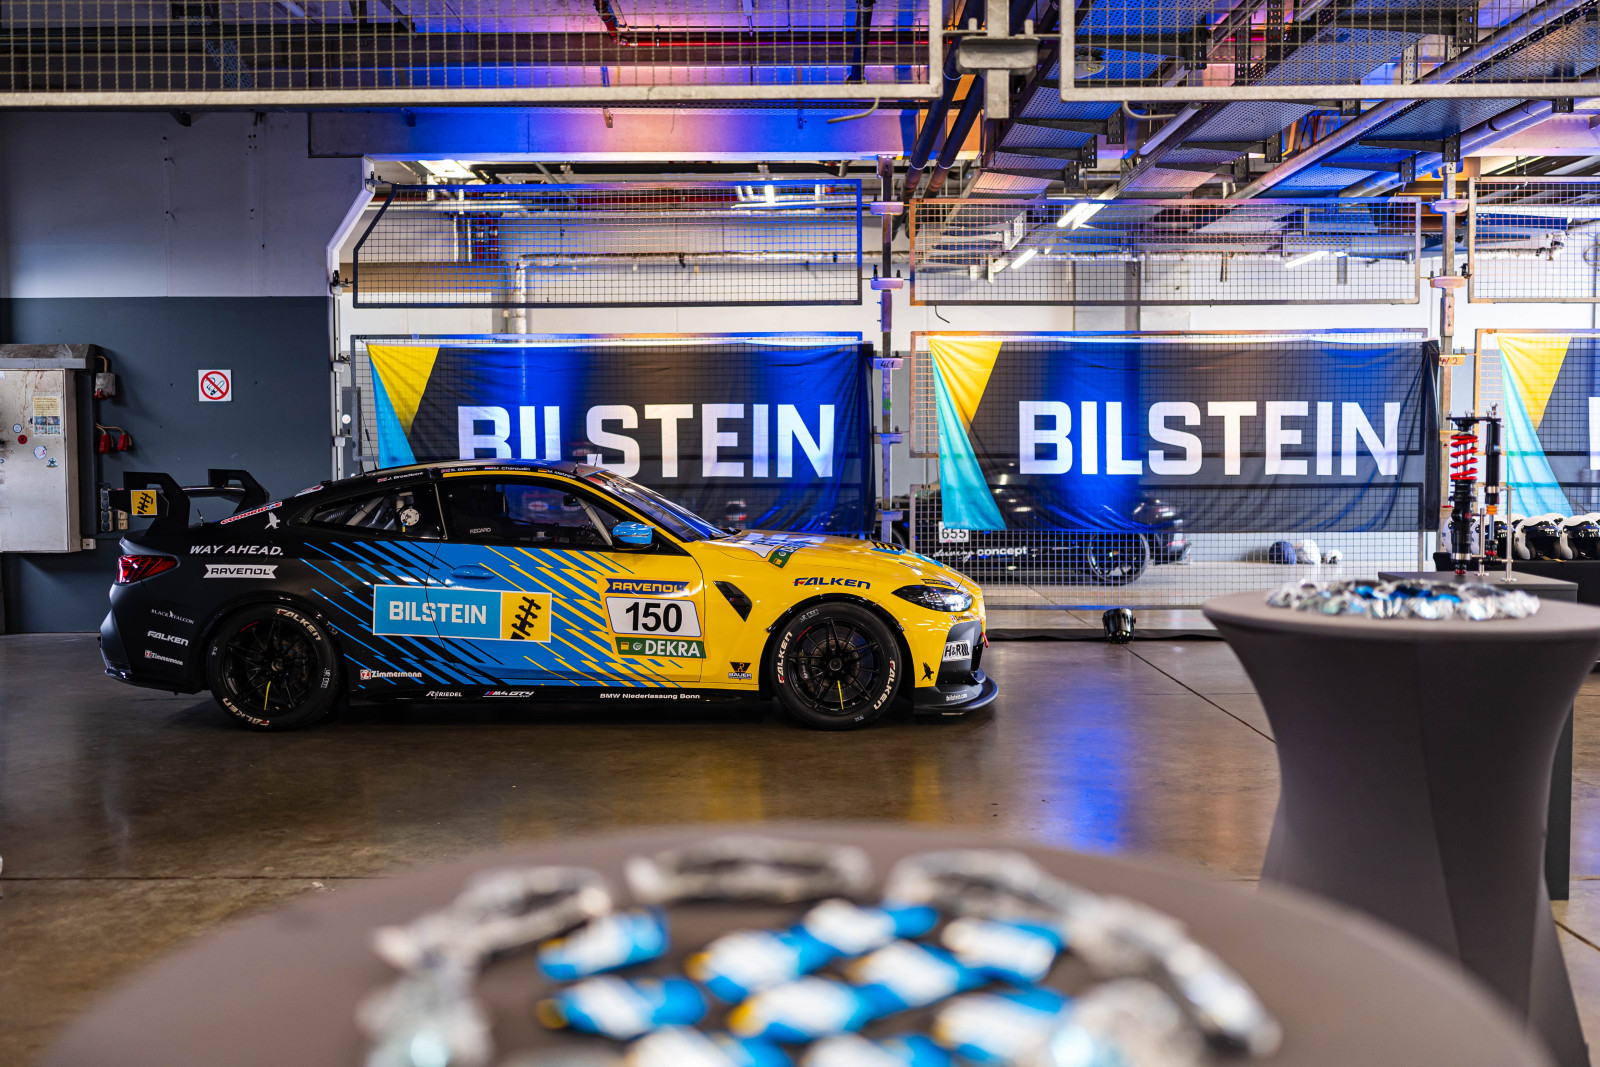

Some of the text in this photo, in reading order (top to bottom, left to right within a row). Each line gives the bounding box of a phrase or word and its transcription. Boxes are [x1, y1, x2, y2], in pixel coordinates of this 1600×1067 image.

[1018, 401, 1401, 476] BILSTEIN
[190, 544, 284, 556] WAY AHEAD.
[977, 545, 1027, 557] concept
[210, 567, 270, 576] RAVENOL
[612, 581, 680, 593] RAVENOL
[792, 576, 871, 590] FALKEN
[151, 608, 195, 625] BLACK FALCON
[389, 600, 487, 625] BILSTEIN
[625, 601, 683, 632] 150
[277, 608, 322, 641] FALKEN
[147, 630, 189, 646] FALKEN
[645, 639, 701, 657] DEKRA
[776, 631, 793, 684] FALKEN
[371, 670, 422, 678] Zimmermann
[873, 657, 896, 710] FALKEN
[222, 697, 270, 726] FALKEN
